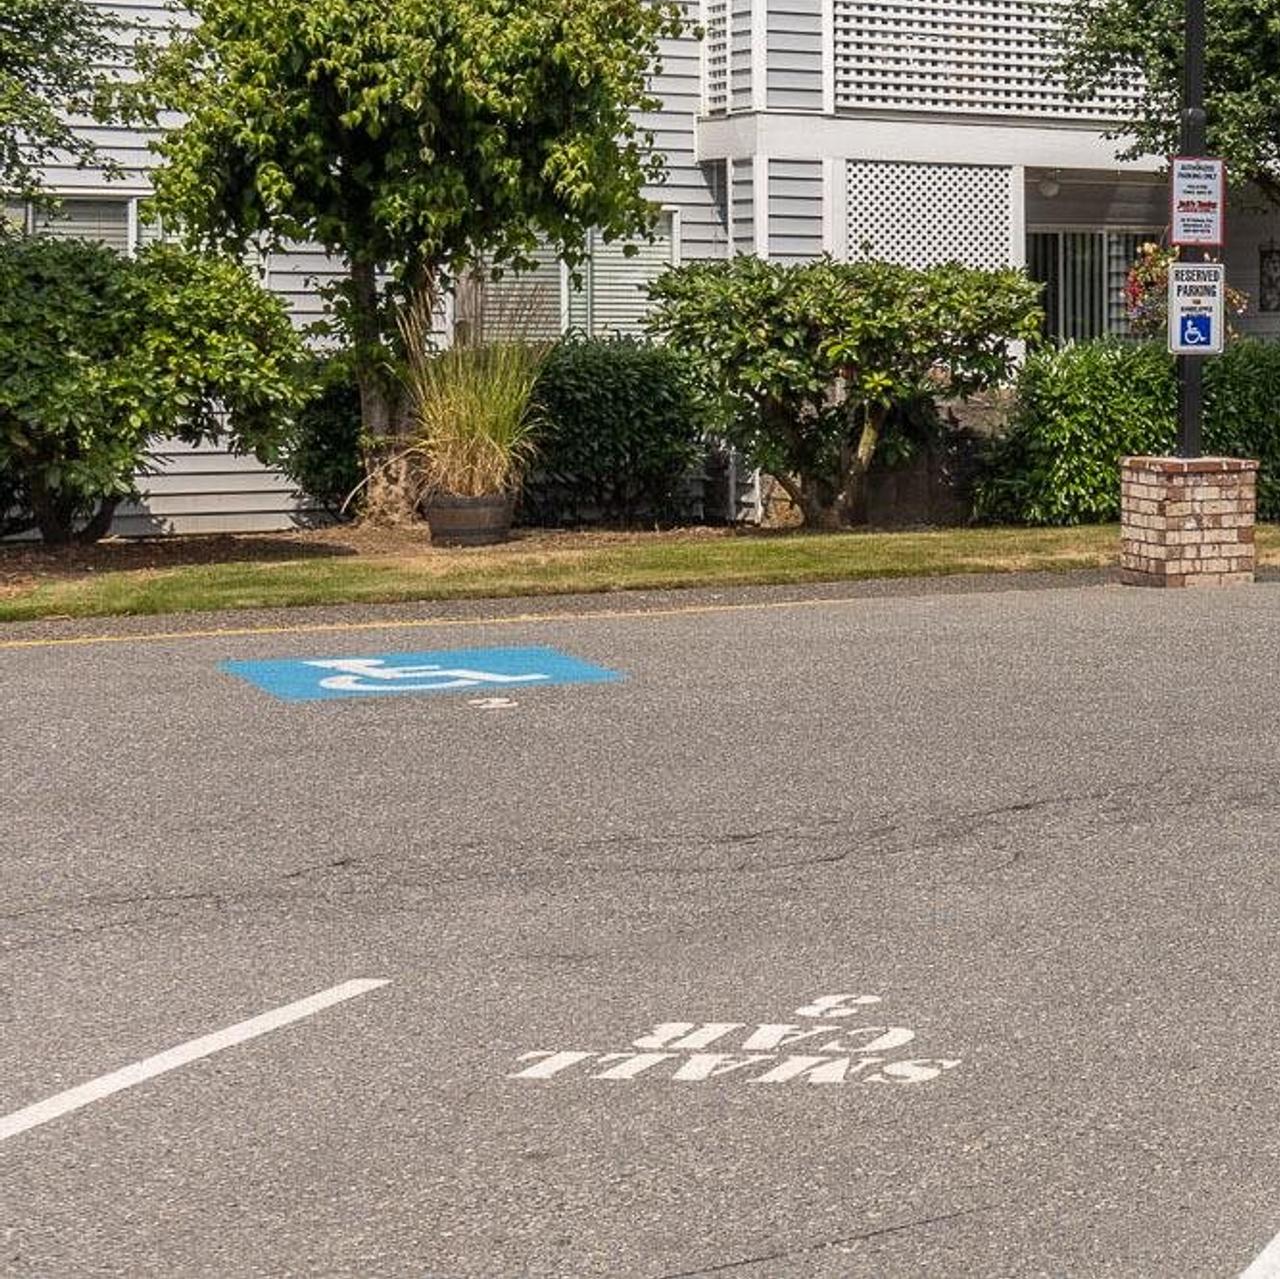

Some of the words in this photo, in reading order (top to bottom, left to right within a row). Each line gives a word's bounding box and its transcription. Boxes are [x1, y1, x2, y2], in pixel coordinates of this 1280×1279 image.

[1175, 270, 1220, 282] RESERVED
[1177, 285, 1217, 297] PARKING
[632, 1022, 915, 1052] CAR
[506, 1050, 963, 1083] SMALL
